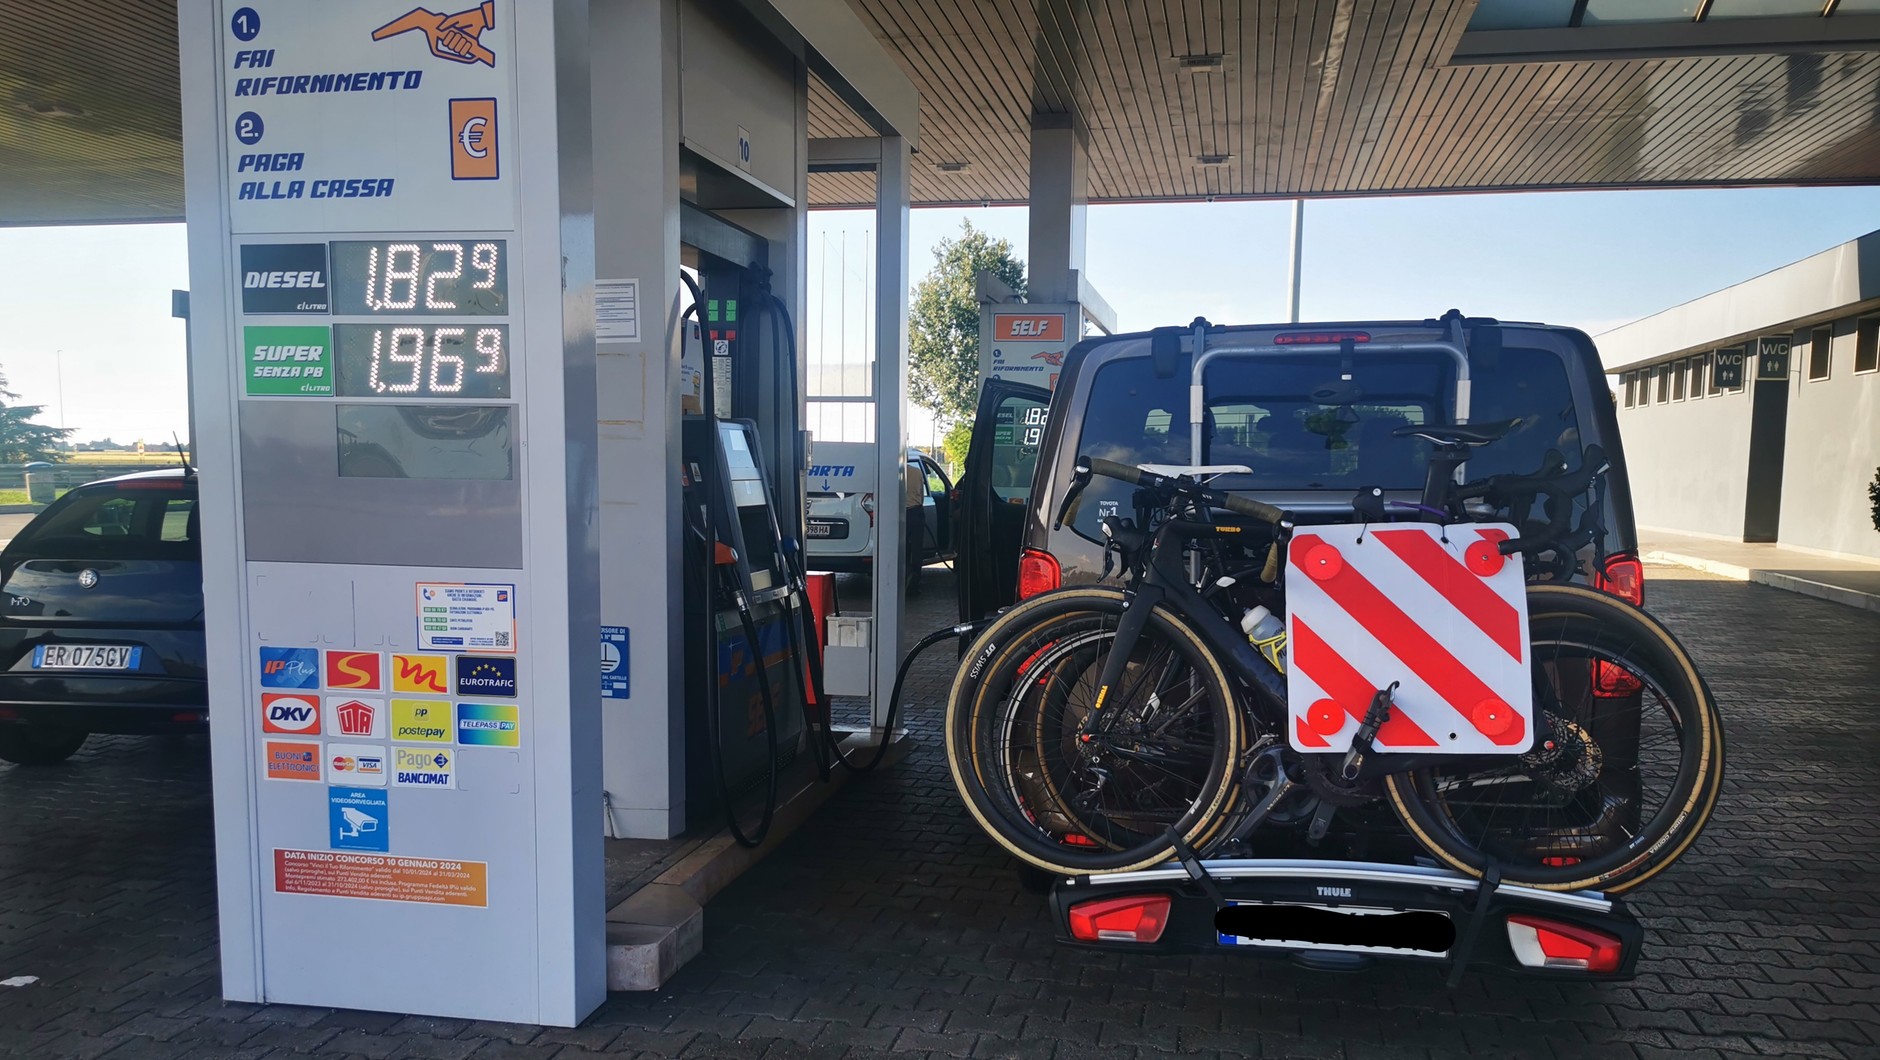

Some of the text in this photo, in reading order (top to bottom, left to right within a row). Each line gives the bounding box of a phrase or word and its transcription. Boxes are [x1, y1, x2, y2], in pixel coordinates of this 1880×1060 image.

[233, 49, 275, 69] FAI
[235, 70, 423, 97] RIFORNIMENTO
[739, 137, 750, 163] 10
[238, 153, 304, 173] PAGA
[238, 178, 394, 200] ALLA CASSA
[244, 271, 326, 289] DIESEL
[1010, 320, 1049, 337] SELF
[253, 346, 324, 362] SUPER
[1762, 343, 1788, 355] WC
[1718, 354, 1742, 366] WC
[253, 366, 324, 379] SENZA PB
[1024, 408, 1049, 426] 1,82
[808, 465, 855, 477] ARTA
[45, 646, 129, 667] ER 075GV
[970, 643, 996, 679] DT SWISS
[264, 660, 316, 675] IP Plus
[460, 678, 514, 688] EUROTRAFIC
[270, 706, 312, 721] DKV
[338, 700, 373, 734] UTA
[399, 727, 445, 738] postepay
[462, 721, 515, 730] TELEPASS PAY
[268, 762, 319, 772] ELETTRONICI
[398, 750, 432, 769] Pago
[398, 772, 449, 785] BANCOMAT
[331, 797, 386, 806] VIDEOSORVEGLIATA
[284, 852, 462, 870] DATA INIZIO CONCORSO 10 GENNAIO 2024
[1316, 886, 1352, 897] THULE
